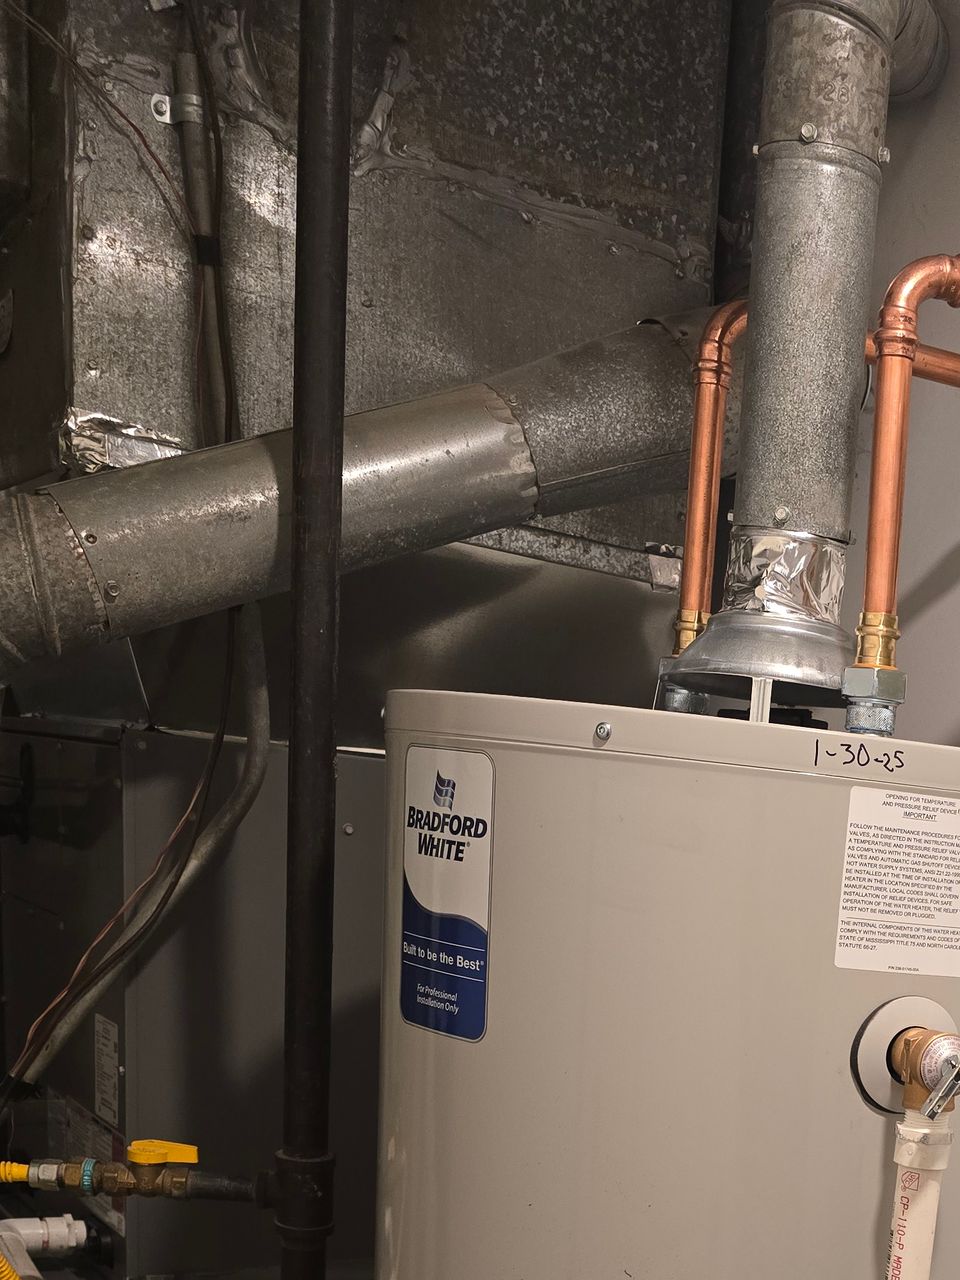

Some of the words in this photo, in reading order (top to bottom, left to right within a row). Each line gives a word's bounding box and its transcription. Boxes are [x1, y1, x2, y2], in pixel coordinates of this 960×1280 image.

[815, 739, 904, 772] 1-30-25
[885, 793, 908, 801] OPENING
[920, 797, 956, 806] TEMPERATURE
[894, 801, 921, 810] PRESSURE
[407, 806, 488, 839] BRADFORD
[903, 811, 936, 820] IMPORTANT
[849, 822, 872, 830] FOLLOW
[884, 826, 920, 835] MAINTENANCE
[921, 831, 953, 839] PROCEDURES
[418, 832, 466, 862] WHITE
[404, 942, 416, 956] Built
[418, 947, 425, 958] to
[427, 948, 437, 961] be
[440, 952, 453, 965] the
[457, 956, 480, 971] Best
[425, 985, 457, 1001] Professional
[417, 994, 444, 1010] Installation
[445, 1002, 459, 1015] Only
[896, 1196, 909, 1250] CP-110-P
